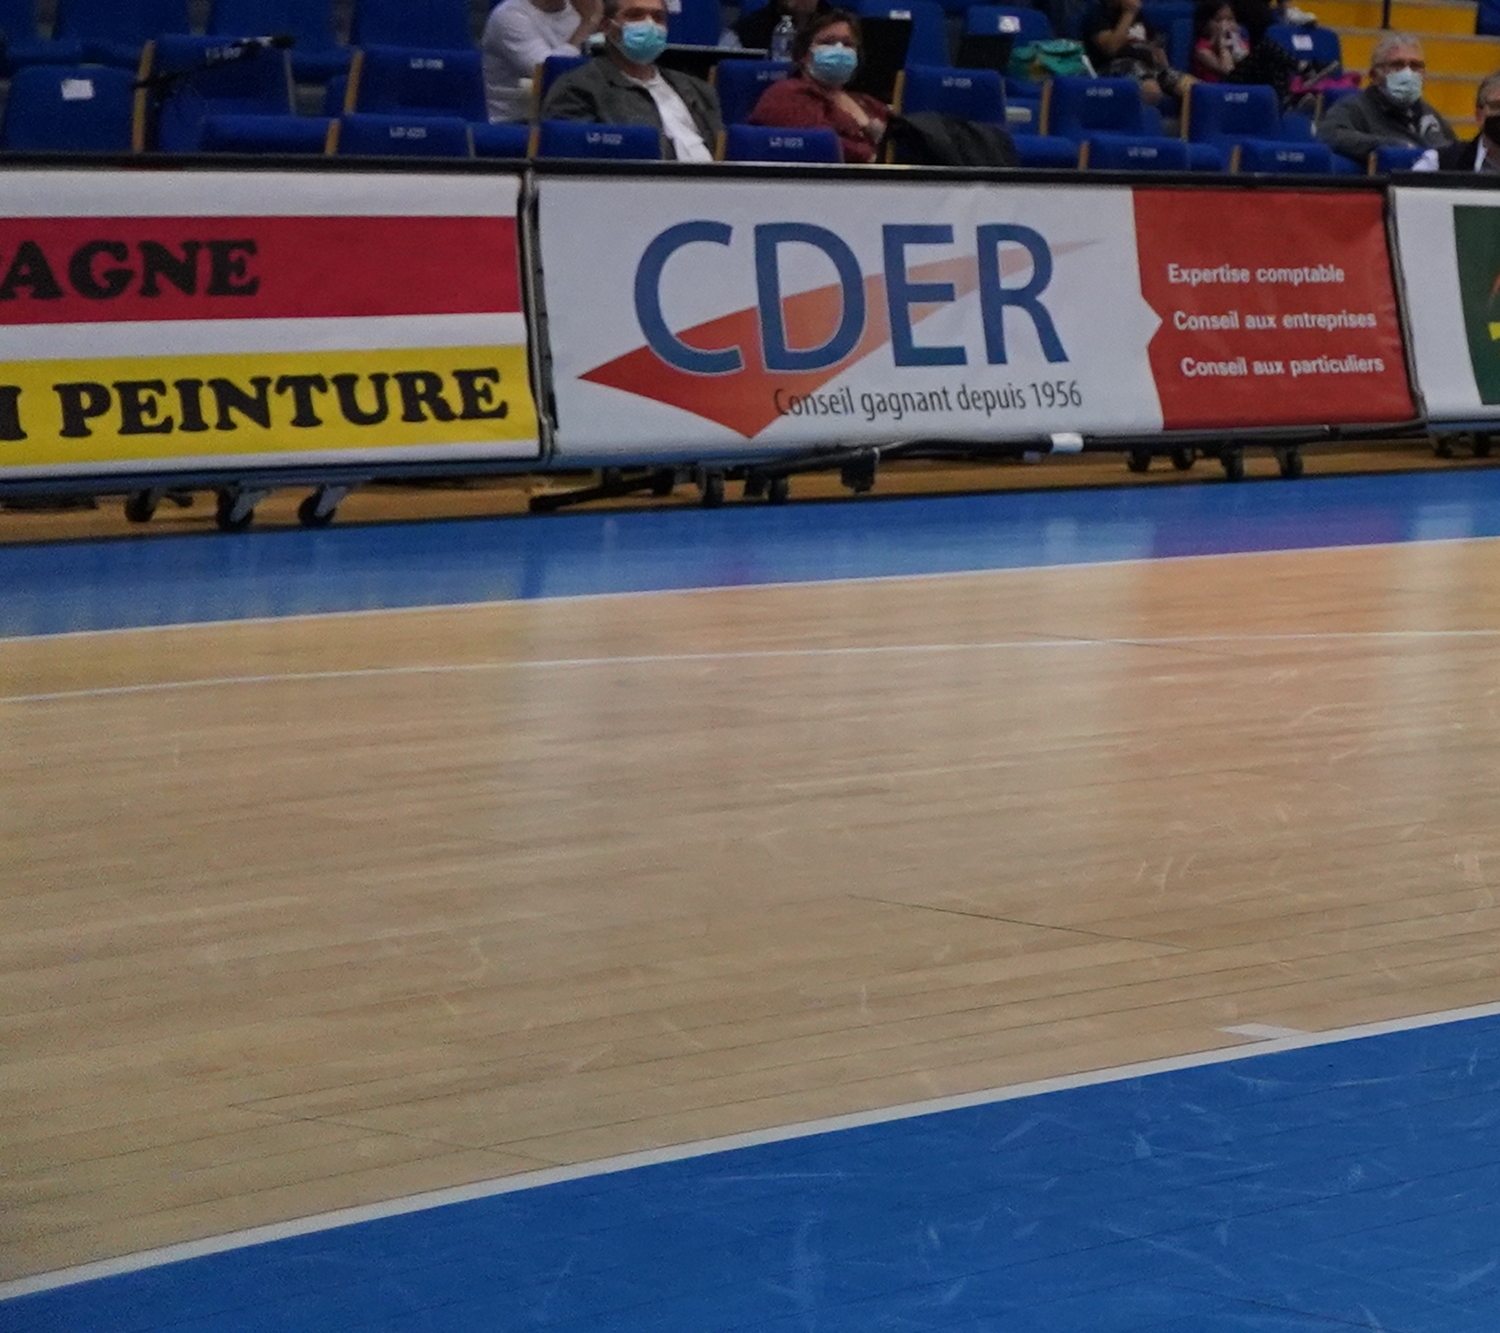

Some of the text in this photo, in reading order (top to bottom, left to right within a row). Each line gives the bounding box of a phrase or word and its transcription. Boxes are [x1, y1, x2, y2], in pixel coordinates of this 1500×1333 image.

[1167, 263, 1345, 287] Expertise comptable
[634, 219, 1070, 376] CDER
[1173, 309, 1377, 332] Conseil aux entreprises
[1181, 354, 1385, 378] Conseil aux particuliers
[52, 367, 508, 438] PEINTURE
[773, 380, 1083, 421] Conseil gagnant depuis 1956
